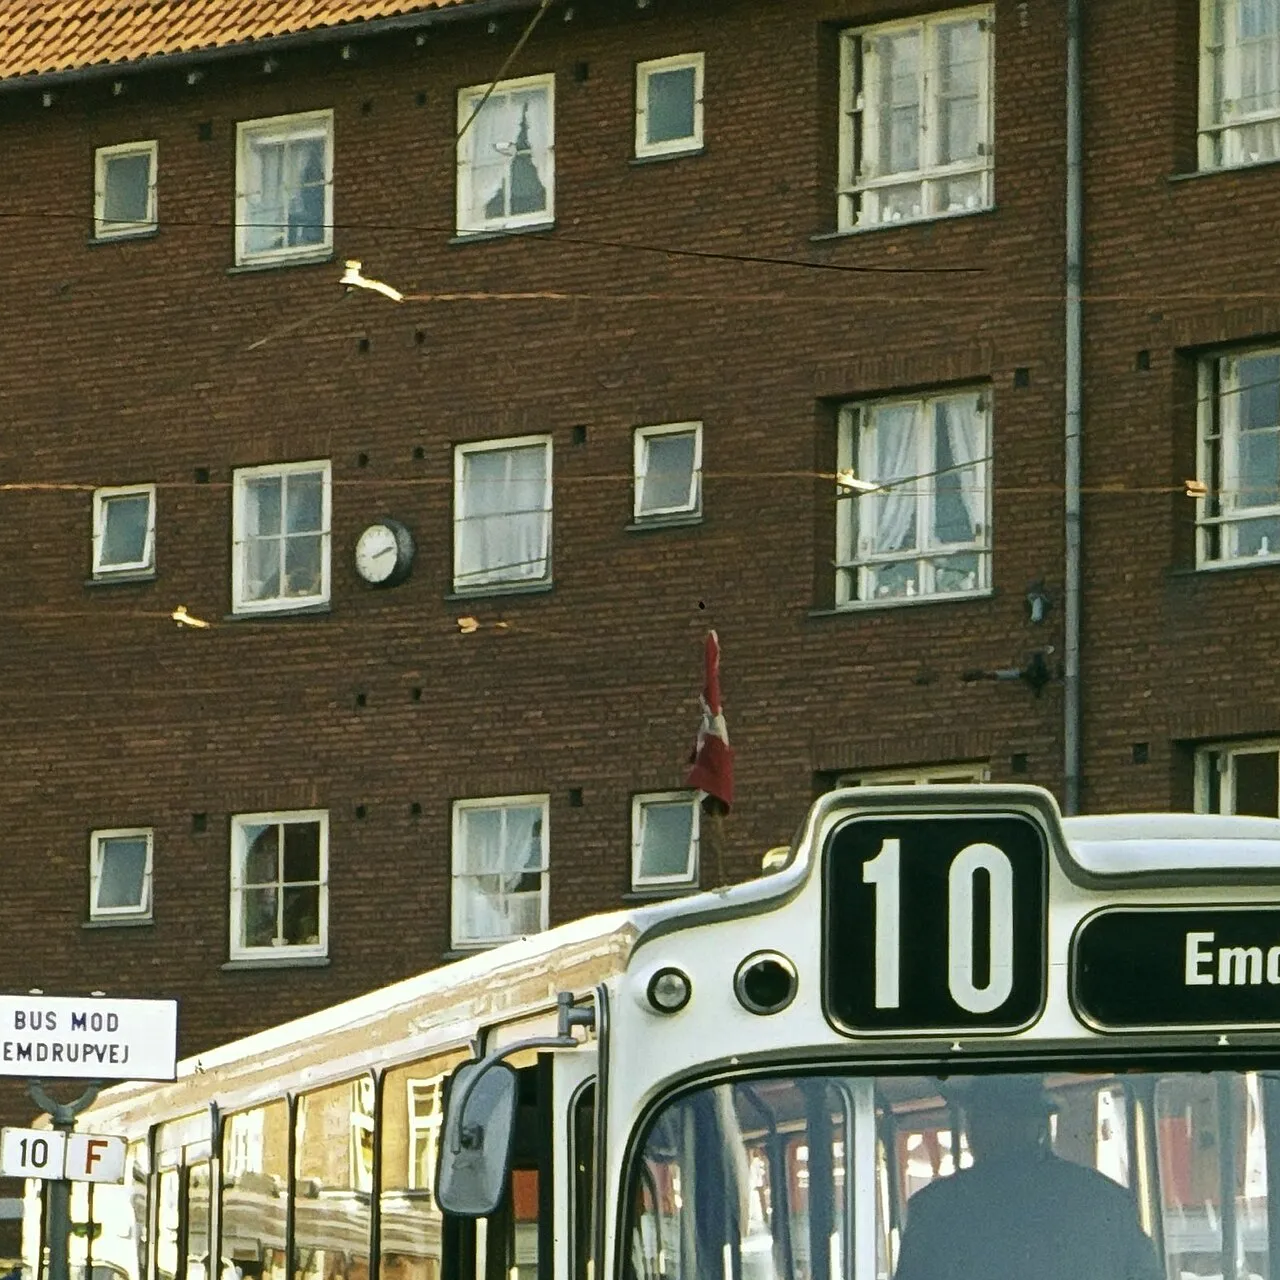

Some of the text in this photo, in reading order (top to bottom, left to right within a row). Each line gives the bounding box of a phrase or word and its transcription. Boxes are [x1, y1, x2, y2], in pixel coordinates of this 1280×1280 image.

[861, 838, 1014, 1014] 10
[13, 1010, 119, 1032] BUS MOD
[3, 1041, 129, 1064] EMDRUPVEJ
[19, 1138, 49, 1168] 10
[84, 1140, 108, 1174] F
